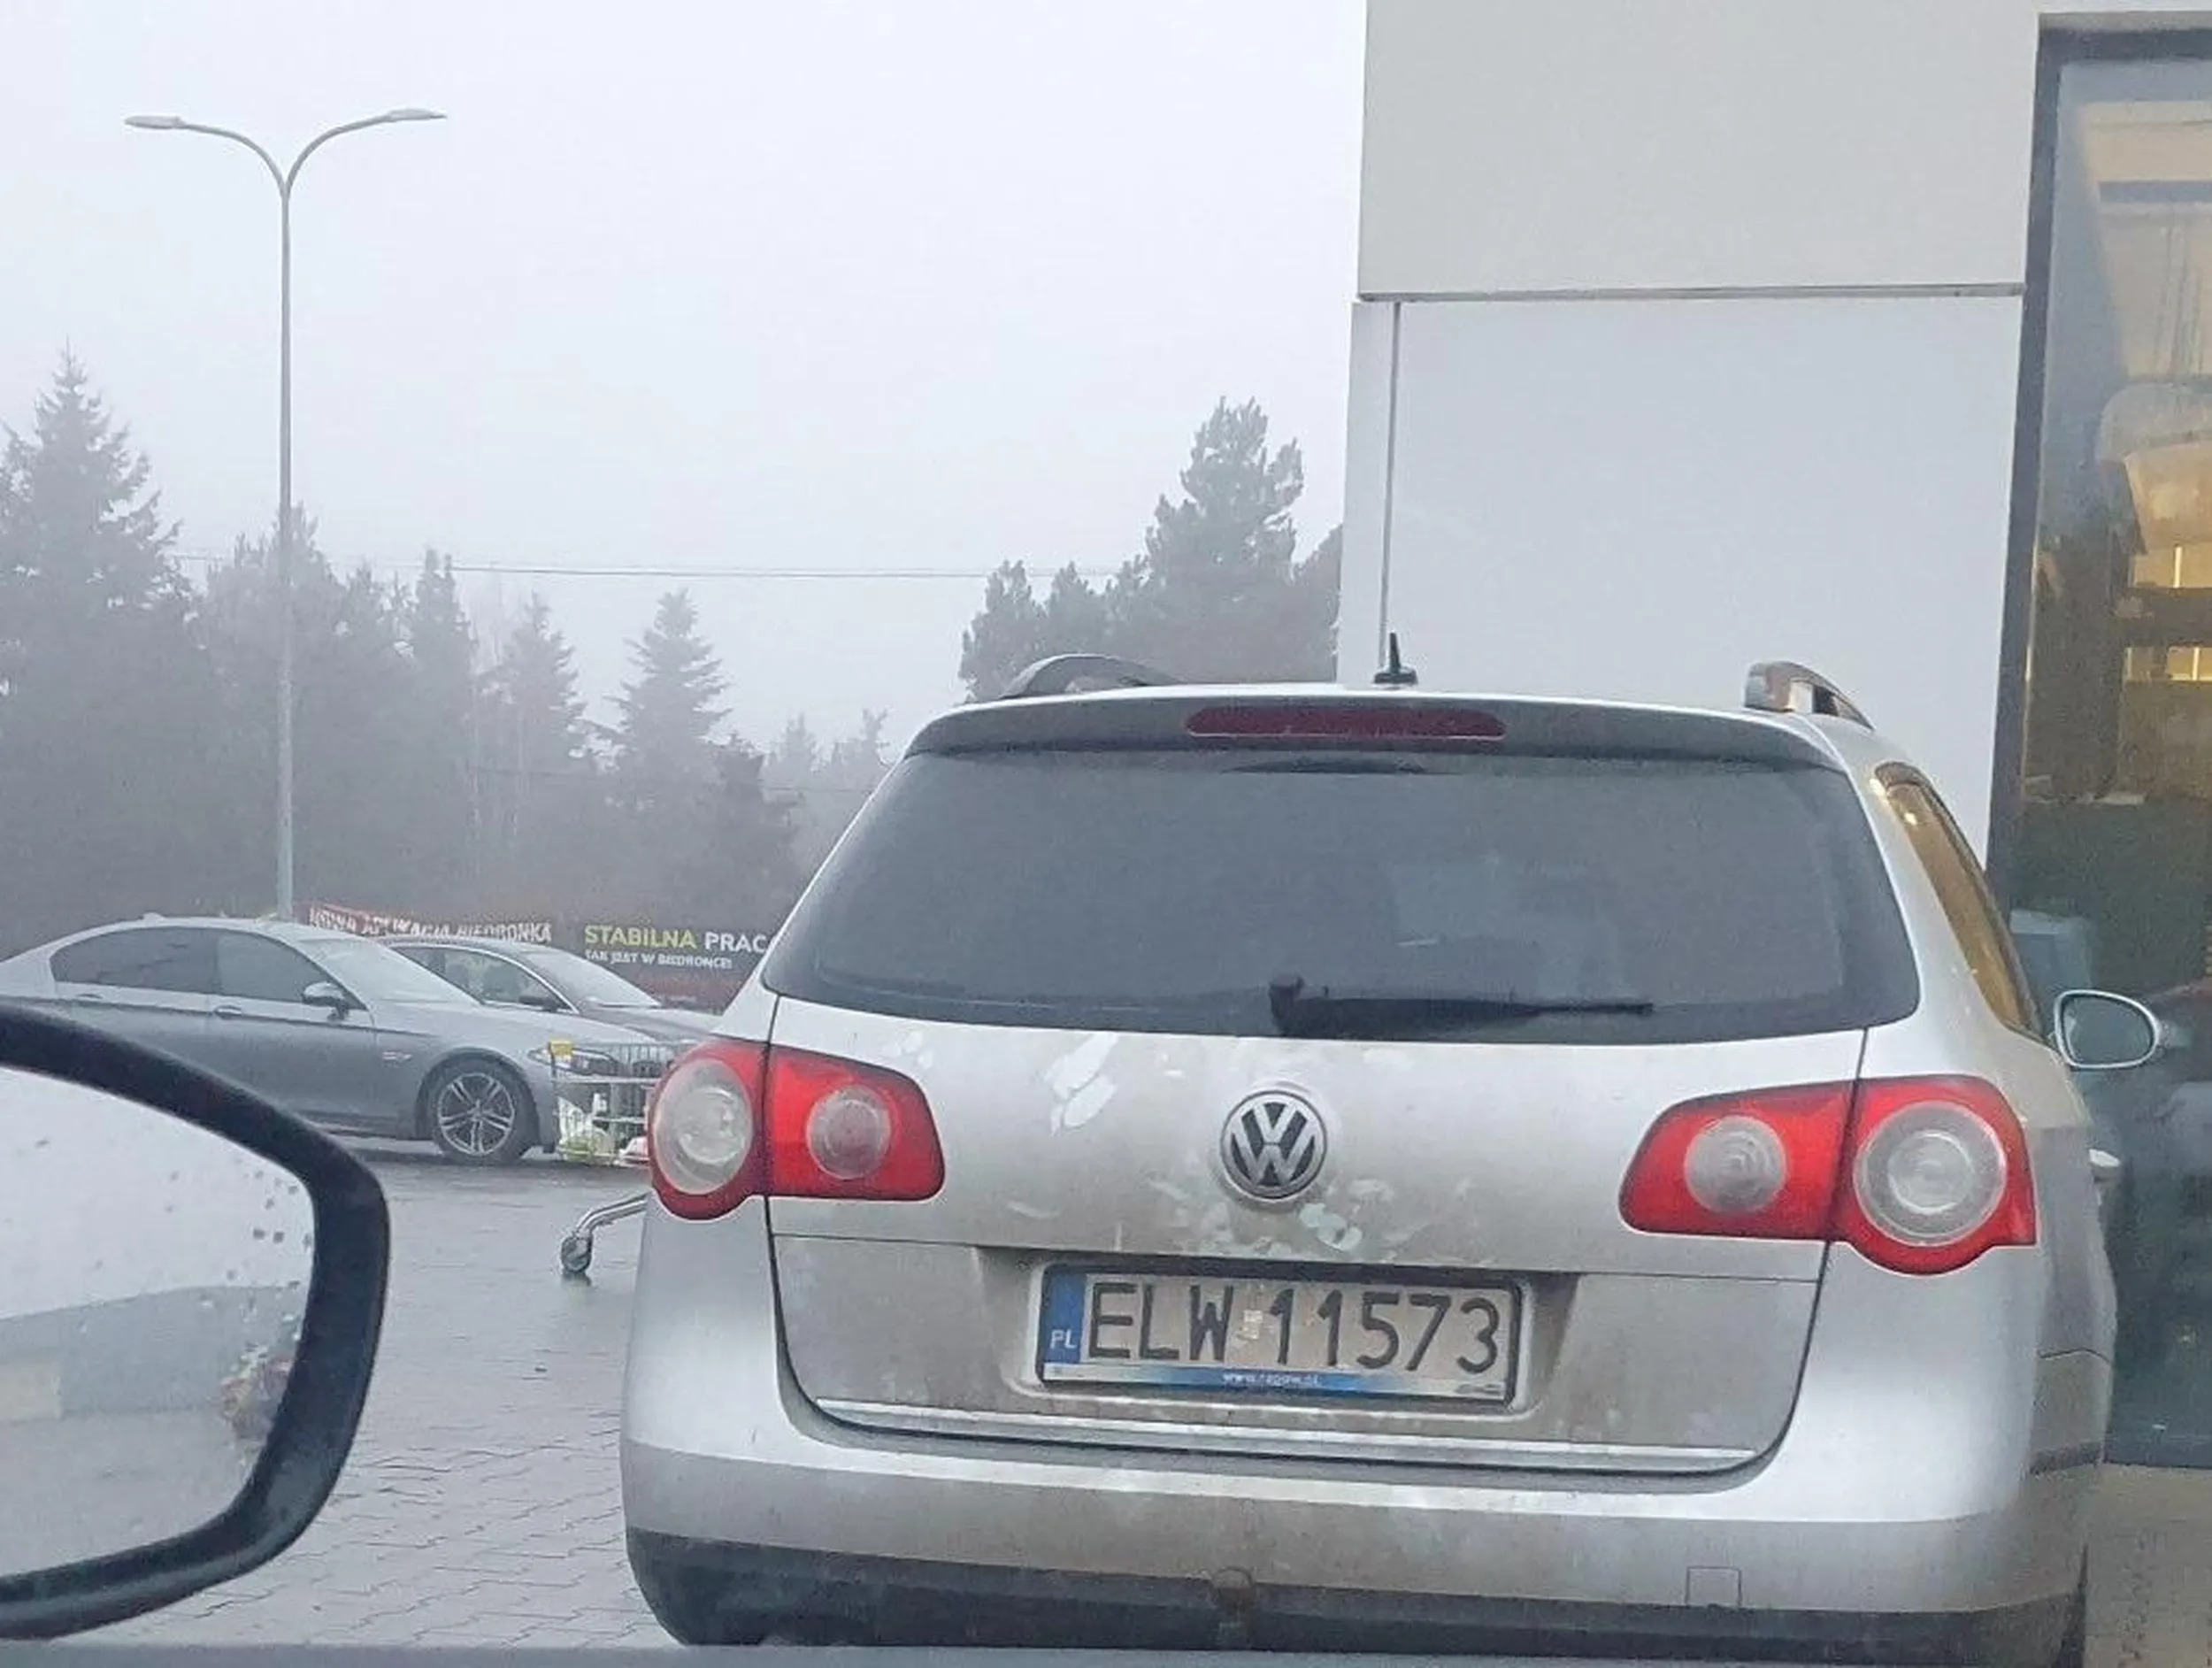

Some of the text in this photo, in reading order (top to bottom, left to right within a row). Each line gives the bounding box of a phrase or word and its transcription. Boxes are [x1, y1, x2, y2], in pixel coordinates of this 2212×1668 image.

[584, 925, 697, 949] STABILNA
[641, 954, 654, 965] W
[1049, 1329, 1077, 1349] PL
[1088, 1282, 1501, 1374] ELW 11573
